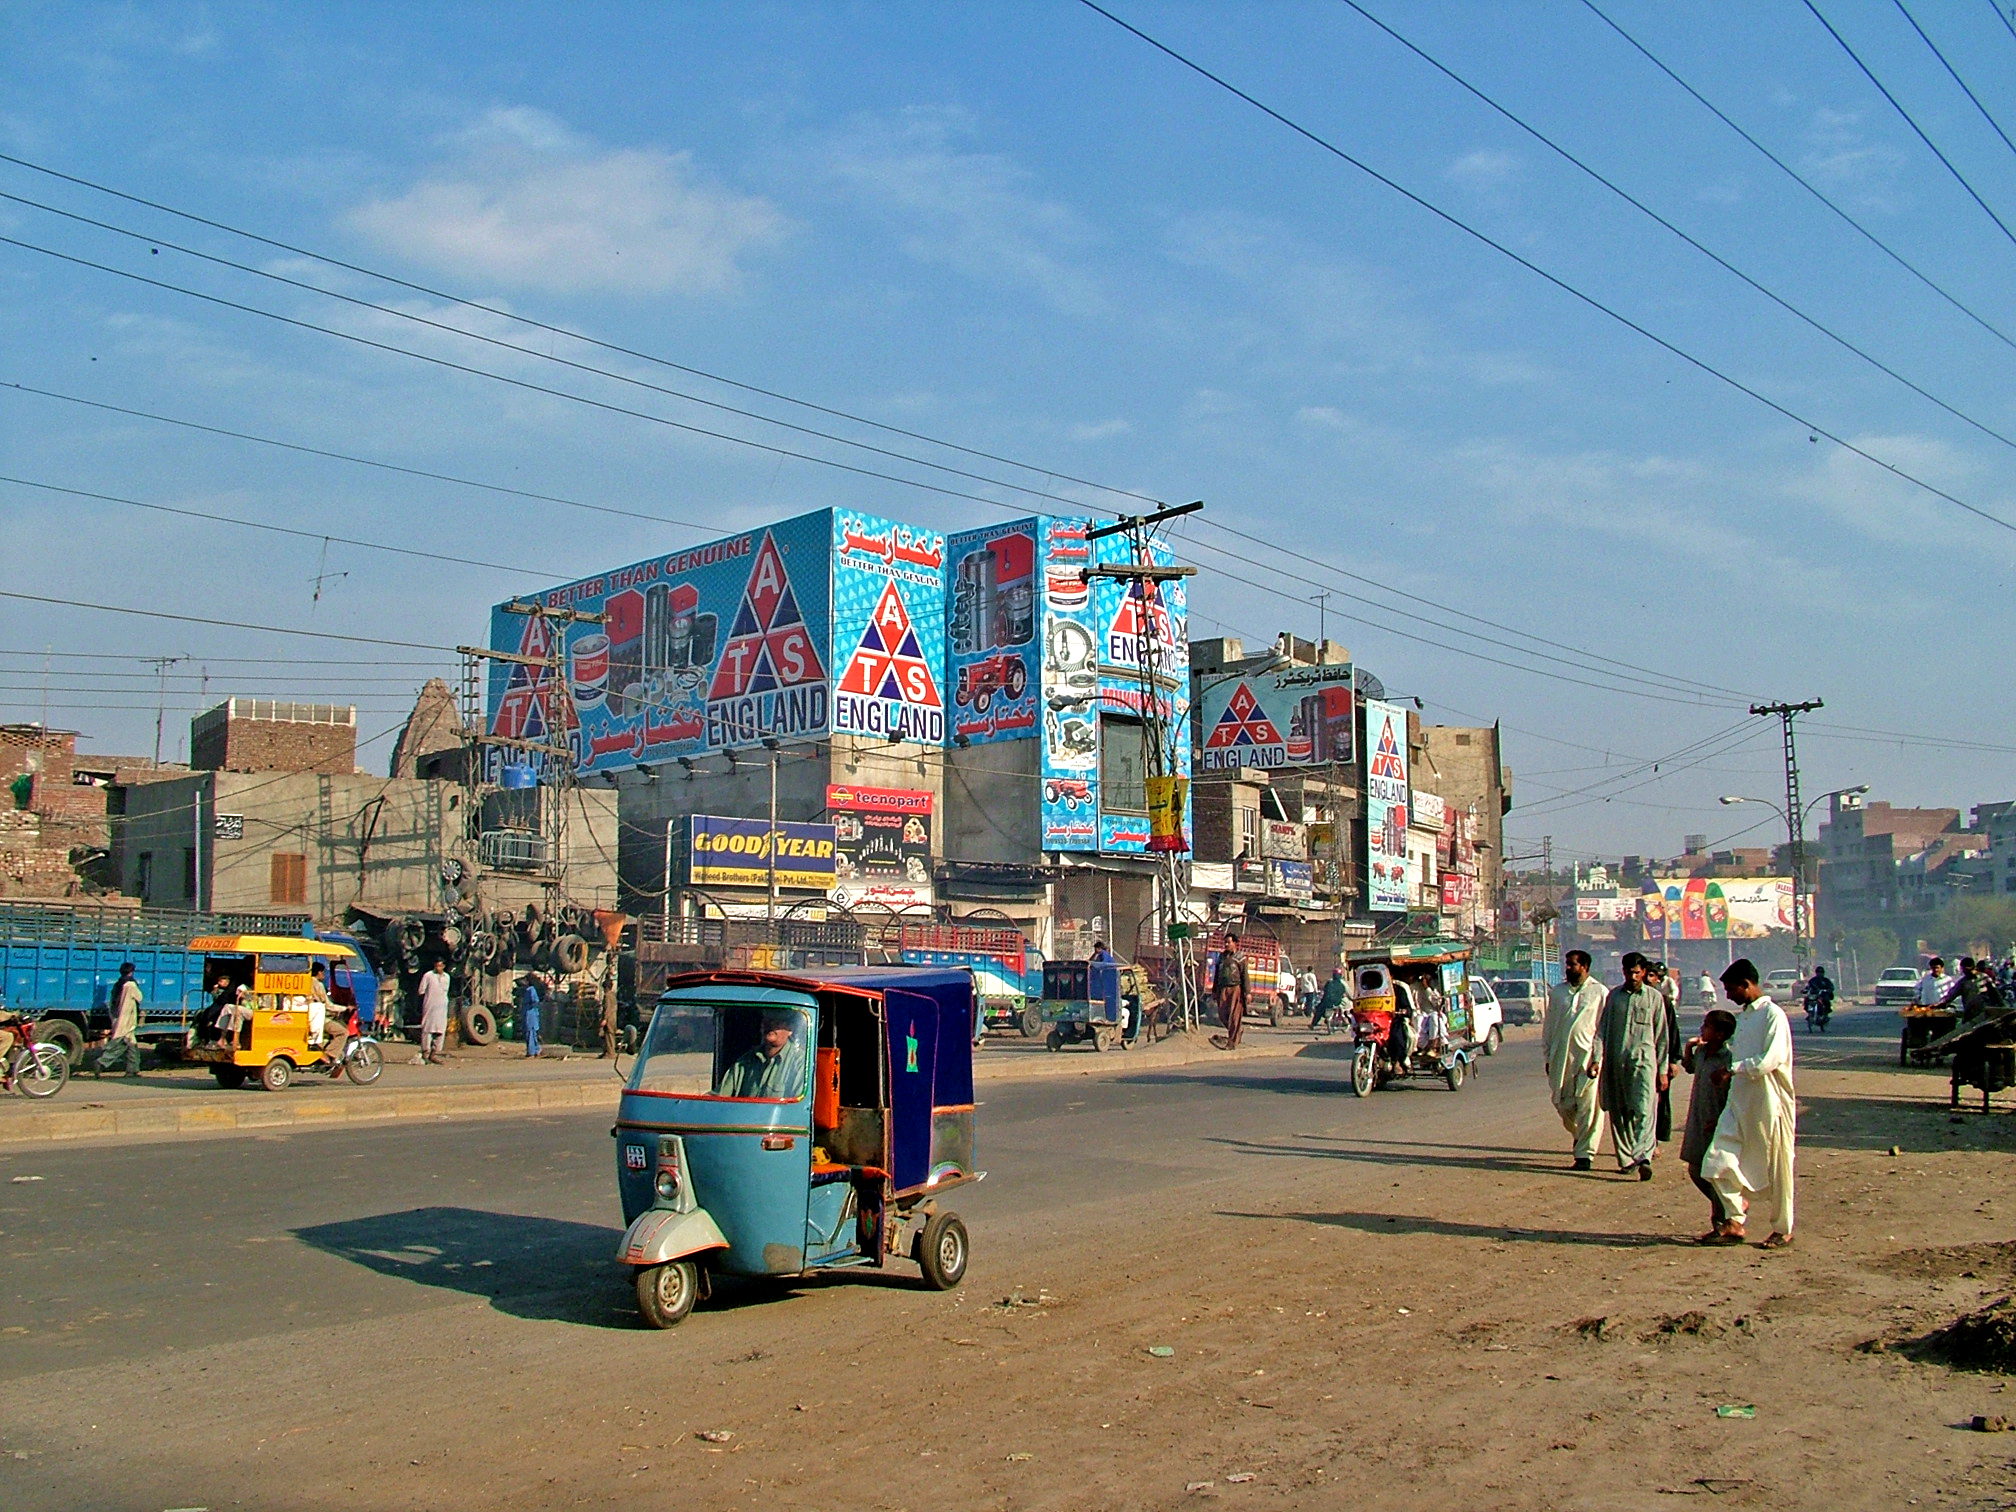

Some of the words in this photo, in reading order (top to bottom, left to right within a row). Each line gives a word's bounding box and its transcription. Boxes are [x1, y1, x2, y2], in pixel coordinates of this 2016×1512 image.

[950, 534, 977, 546] BETTER
[980, 530, 999, 540] THAN
[1002, 522, 1034, 534] GENUINE
[547, 578, 604, 608] BETTER
[610, 561, 659, 591] THAN
[665, 536, 752, 576] GENUINE
[840, 556, 874, 571] BETTER
[877, 565, 901, 579] THAN
[903, 572, 940, 587] GENUINE
[1322, 667, 1352, 682] حافظ
[707, 684, 827, 747] ENGLAND
[836, 696, 943, 742] ENGLAND
[1203, 747, 1285, 770] ENGLAND
[855, 791, 927, 808] tecnopart
[1370, 778, 1406, 803] ENGLAND
[695, 831, 834, 859] GOODYEAR
[722, 872, 750, 883] Brothers
[191, 939, 235, 949] QINGQI
[263, 973, 304, 990] QINGQI
